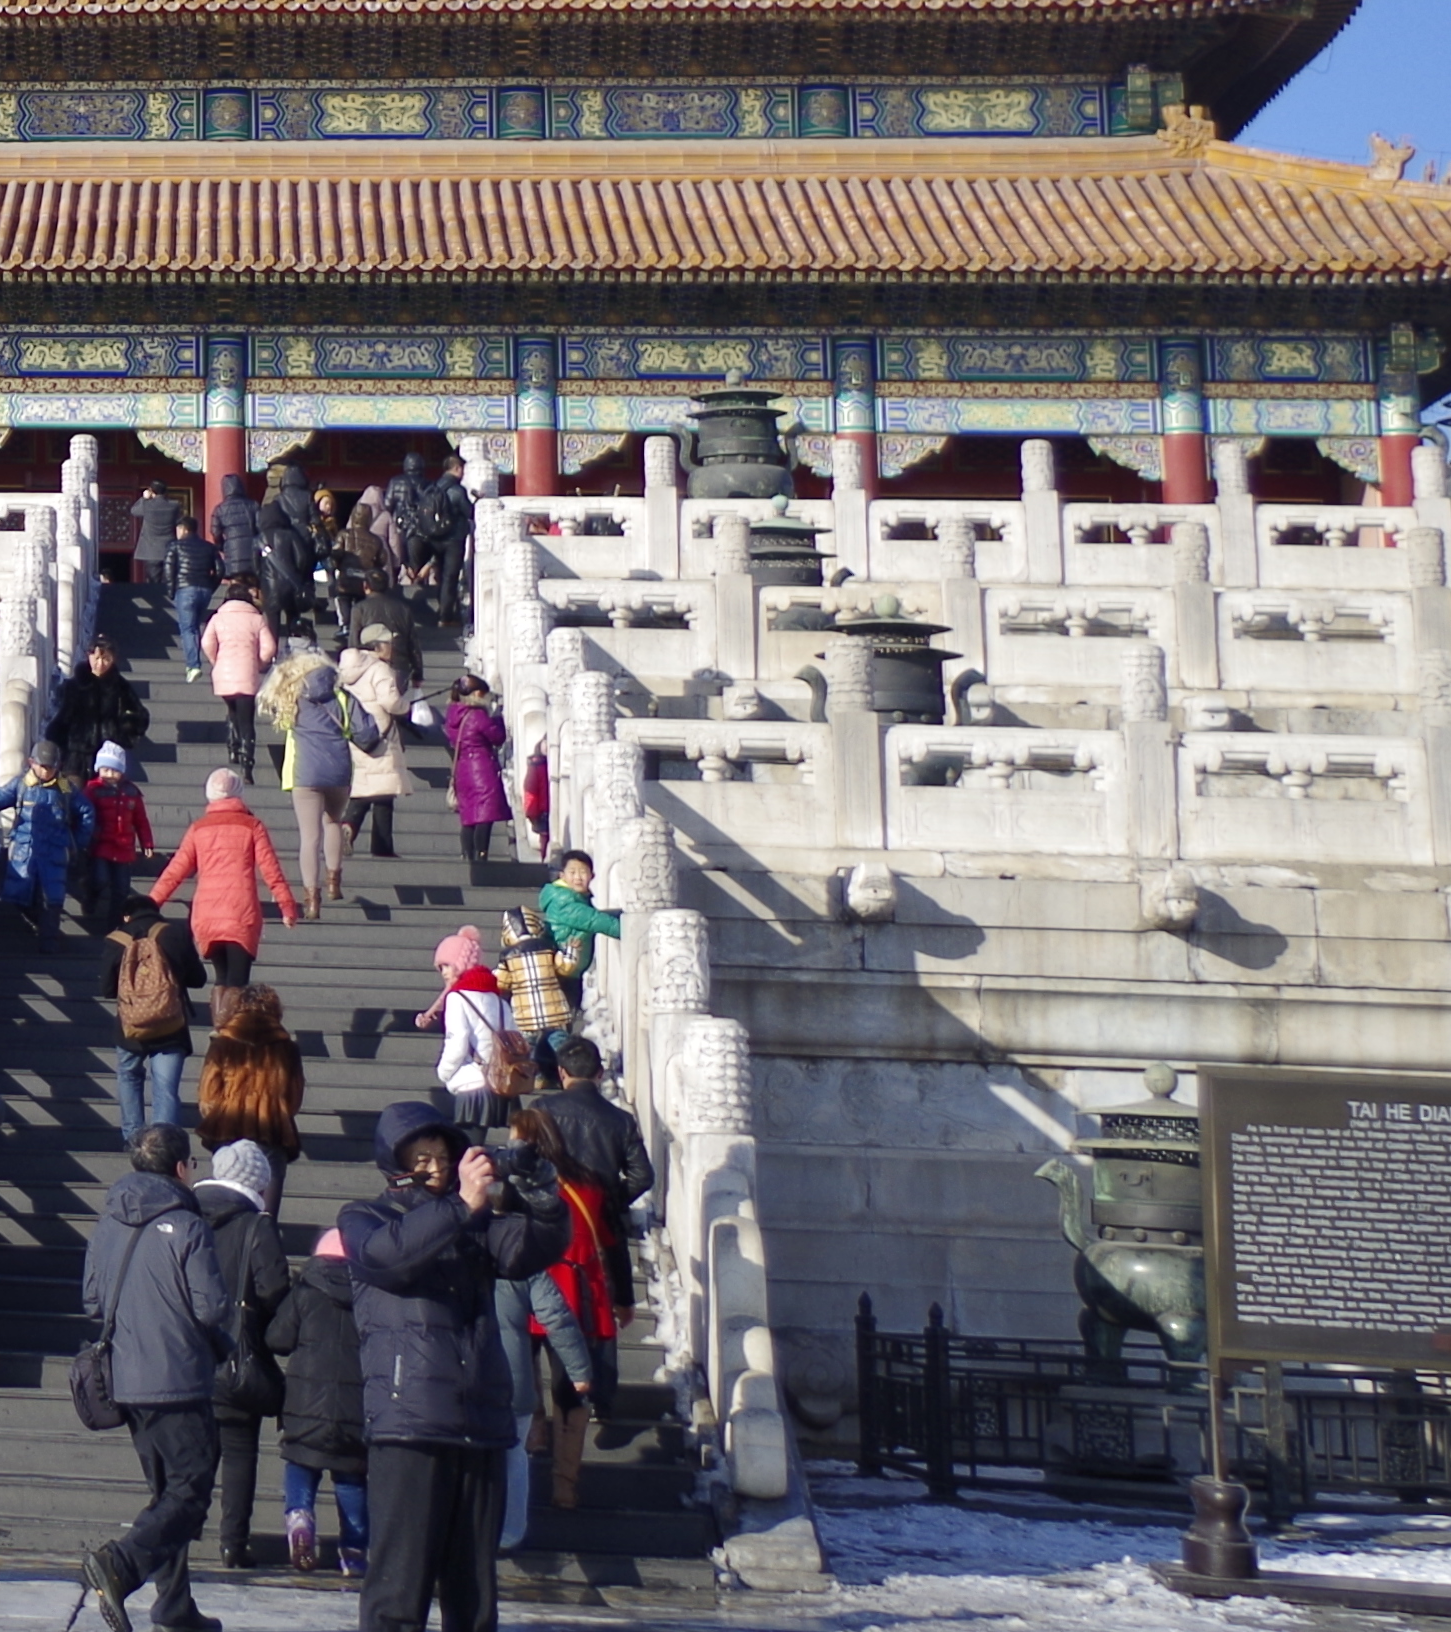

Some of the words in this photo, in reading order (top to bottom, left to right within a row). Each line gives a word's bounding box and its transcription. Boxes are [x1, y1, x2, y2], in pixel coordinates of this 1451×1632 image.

[1346, 1101, 1378, 1118] TAI
[1385, 1103, 1412, 1121] HE
[1419, 1104, 1451, 1122] DIA
